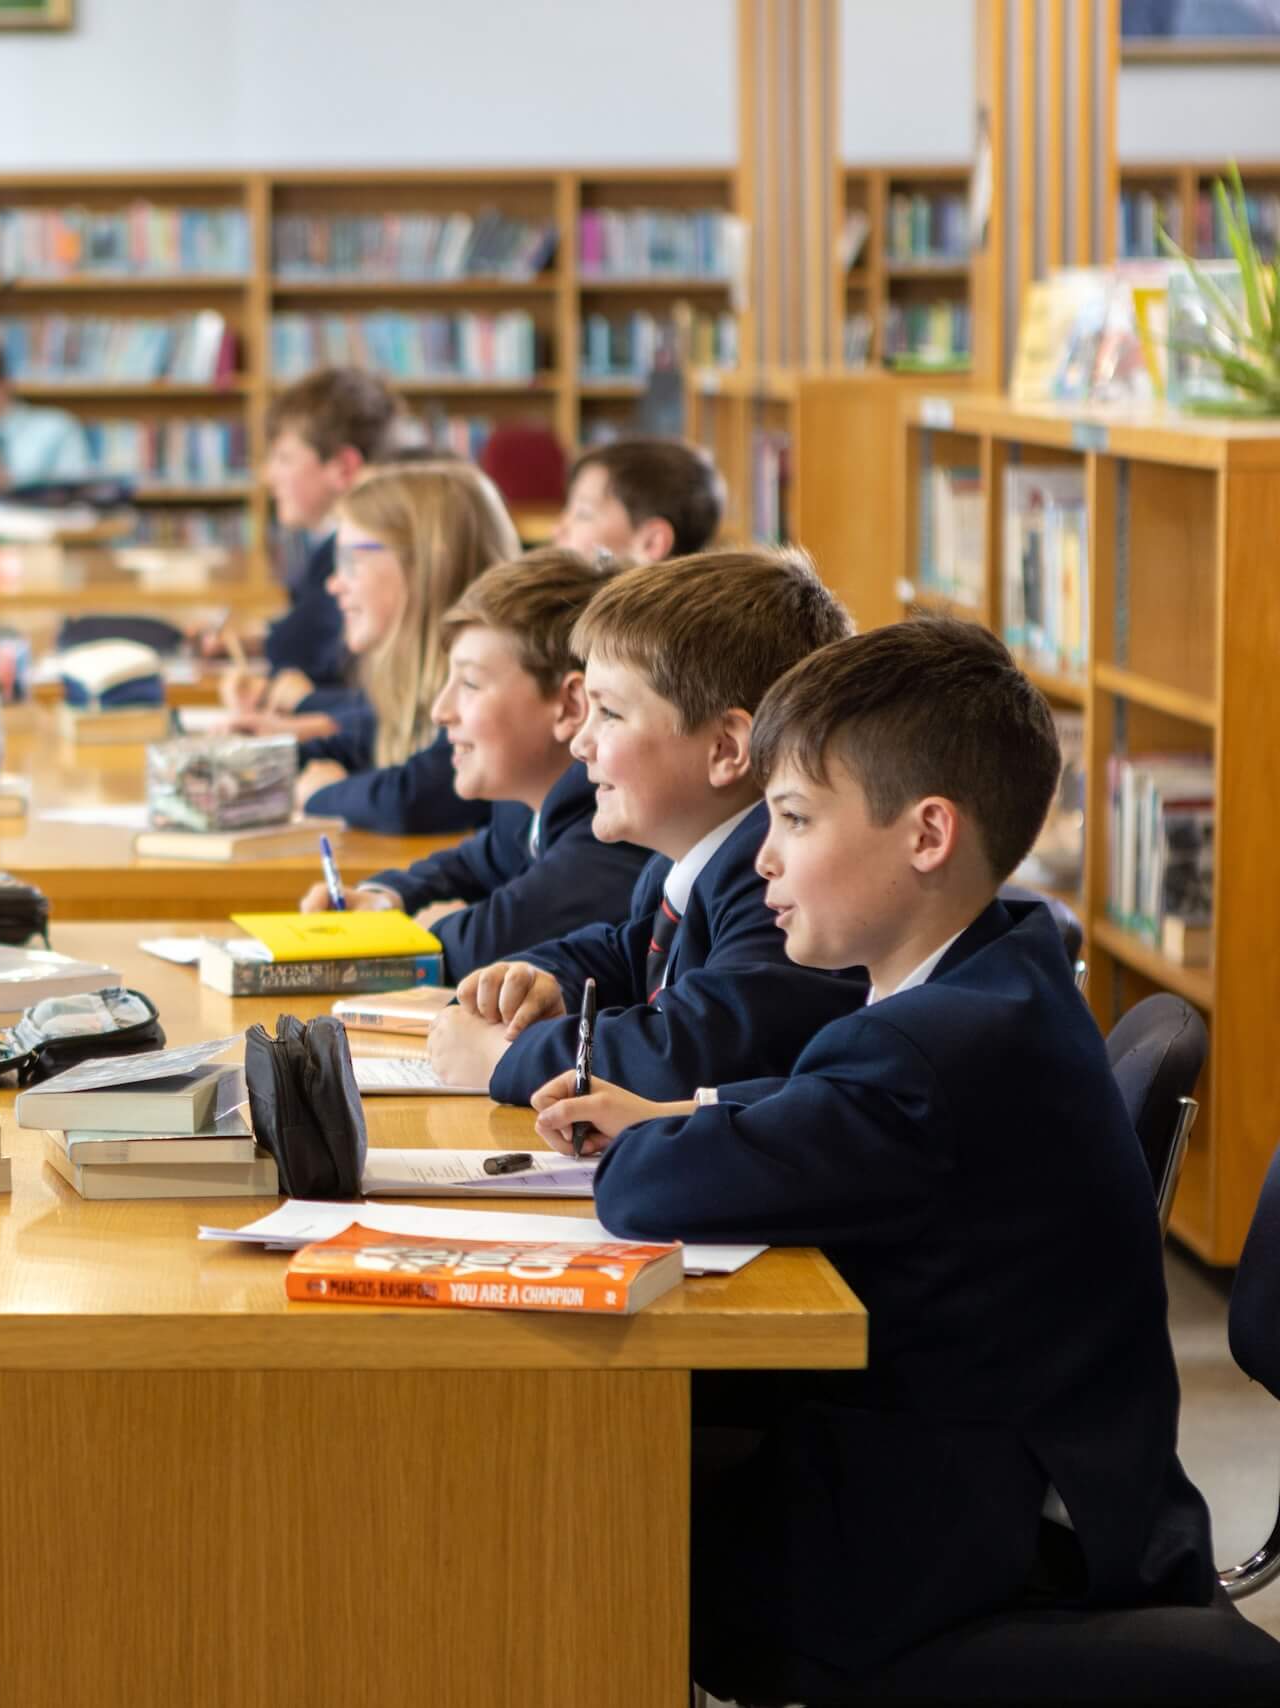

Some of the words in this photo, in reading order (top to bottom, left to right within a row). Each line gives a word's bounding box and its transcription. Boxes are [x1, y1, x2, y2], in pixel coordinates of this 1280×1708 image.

[258, 964, 322, 978] MAGNUS
[330, 1279, 376, 1297] MARCUS
[449, 1282, 477, 1303] YOU
[479, 1283, 506, 1304] ARE
[509, 1284, 519, 1304] A
[521, 1285, 585, 1307] CHAMPION
